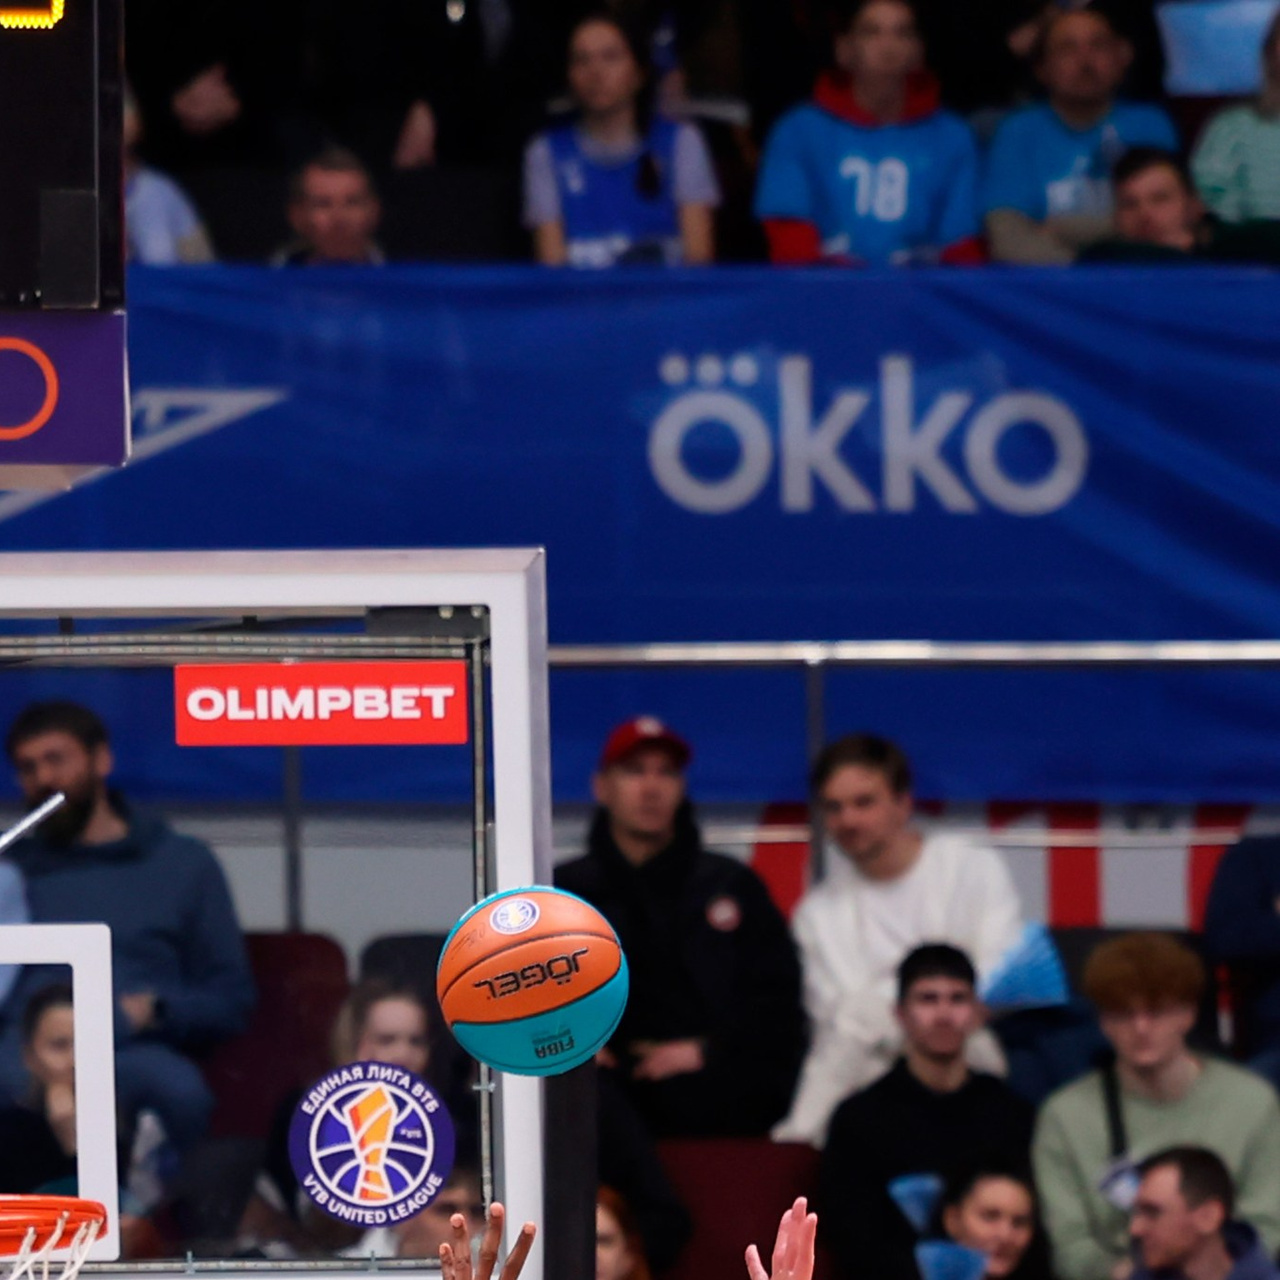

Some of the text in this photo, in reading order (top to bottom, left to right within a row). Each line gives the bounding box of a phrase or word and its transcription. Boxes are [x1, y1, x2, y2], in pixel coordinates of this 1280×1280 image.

[186, 686, 454, 721] OLIMPBET
[301, 1065, 439, 1115] ЕДИНАЯ ЛИГА ВТБ
[303, 1173, 443, 1224] VTB UNITED LEAGUE
